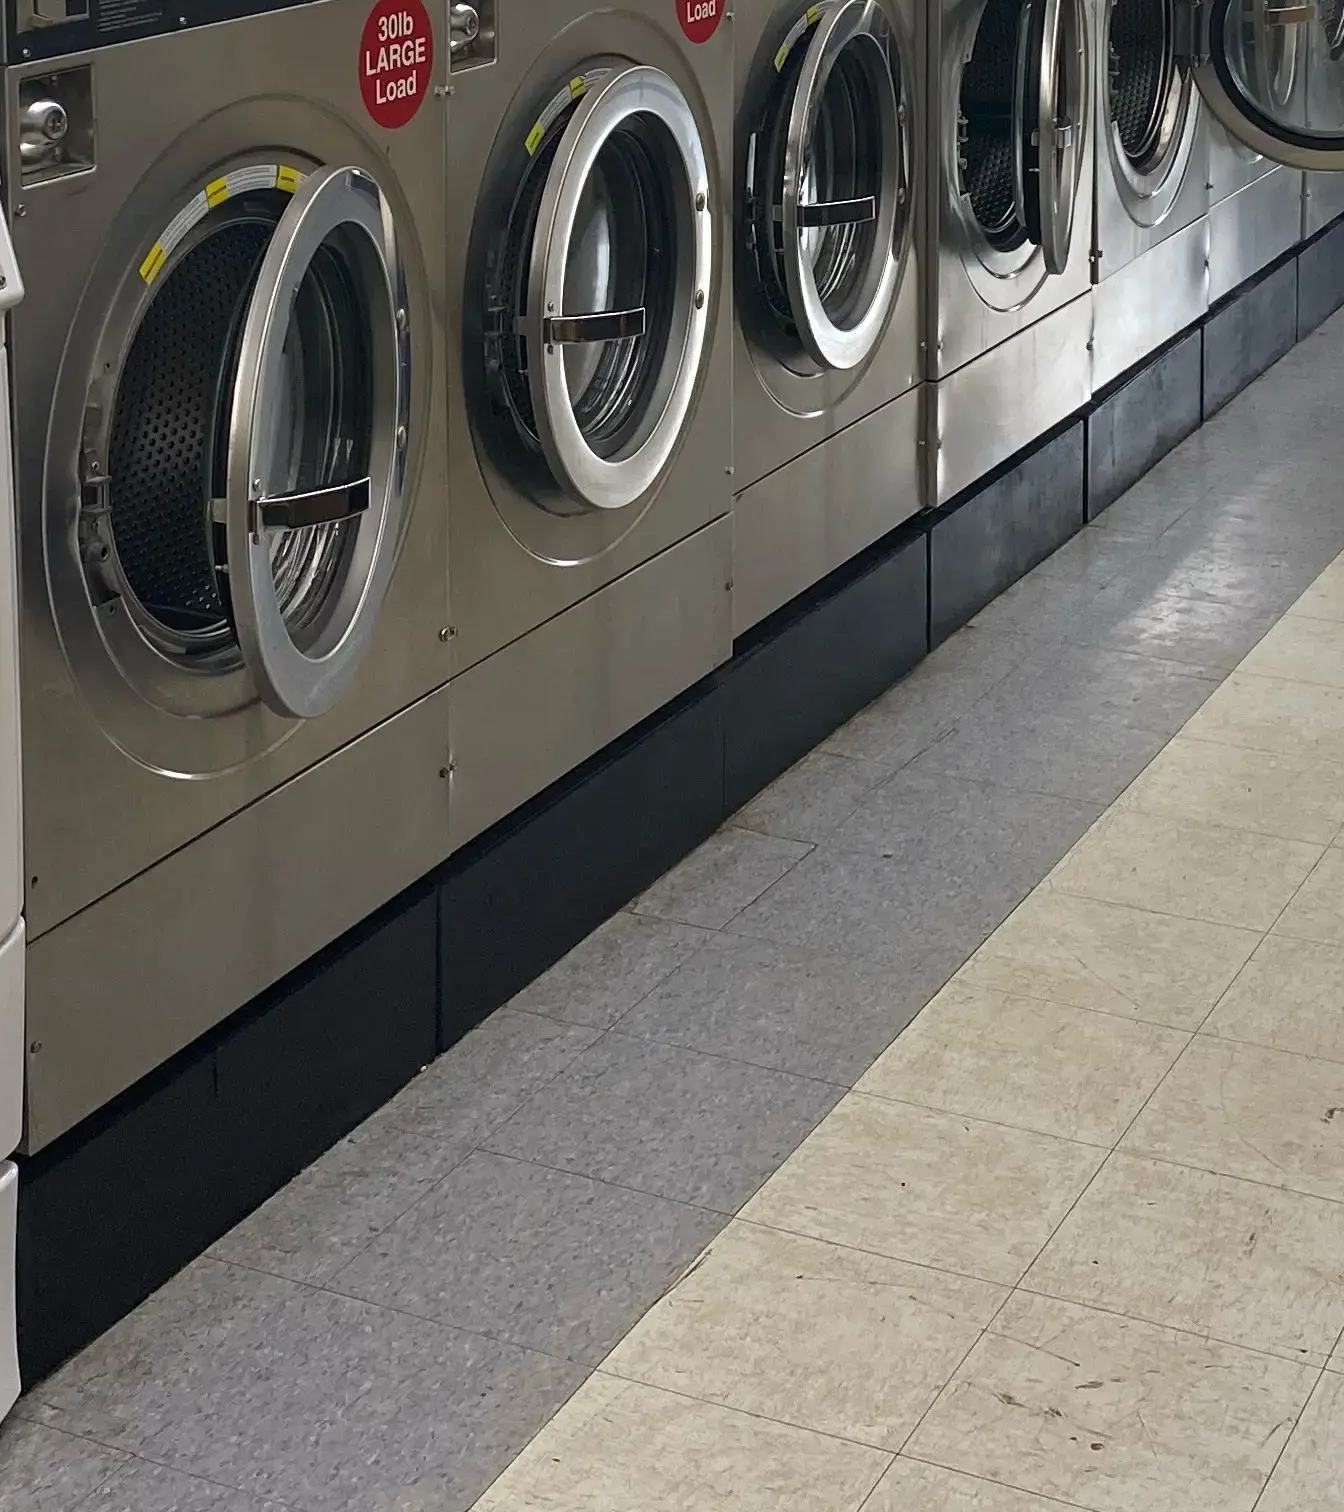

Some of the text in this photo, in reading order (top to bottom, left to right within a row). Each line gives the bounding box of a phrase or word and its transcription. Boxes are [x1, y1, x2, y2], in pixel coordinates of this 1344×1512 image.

[377, 10, 414, 42] 30lb
[365, 37, 426, 76] LARGE
[376, 69, 417, 104] Load
